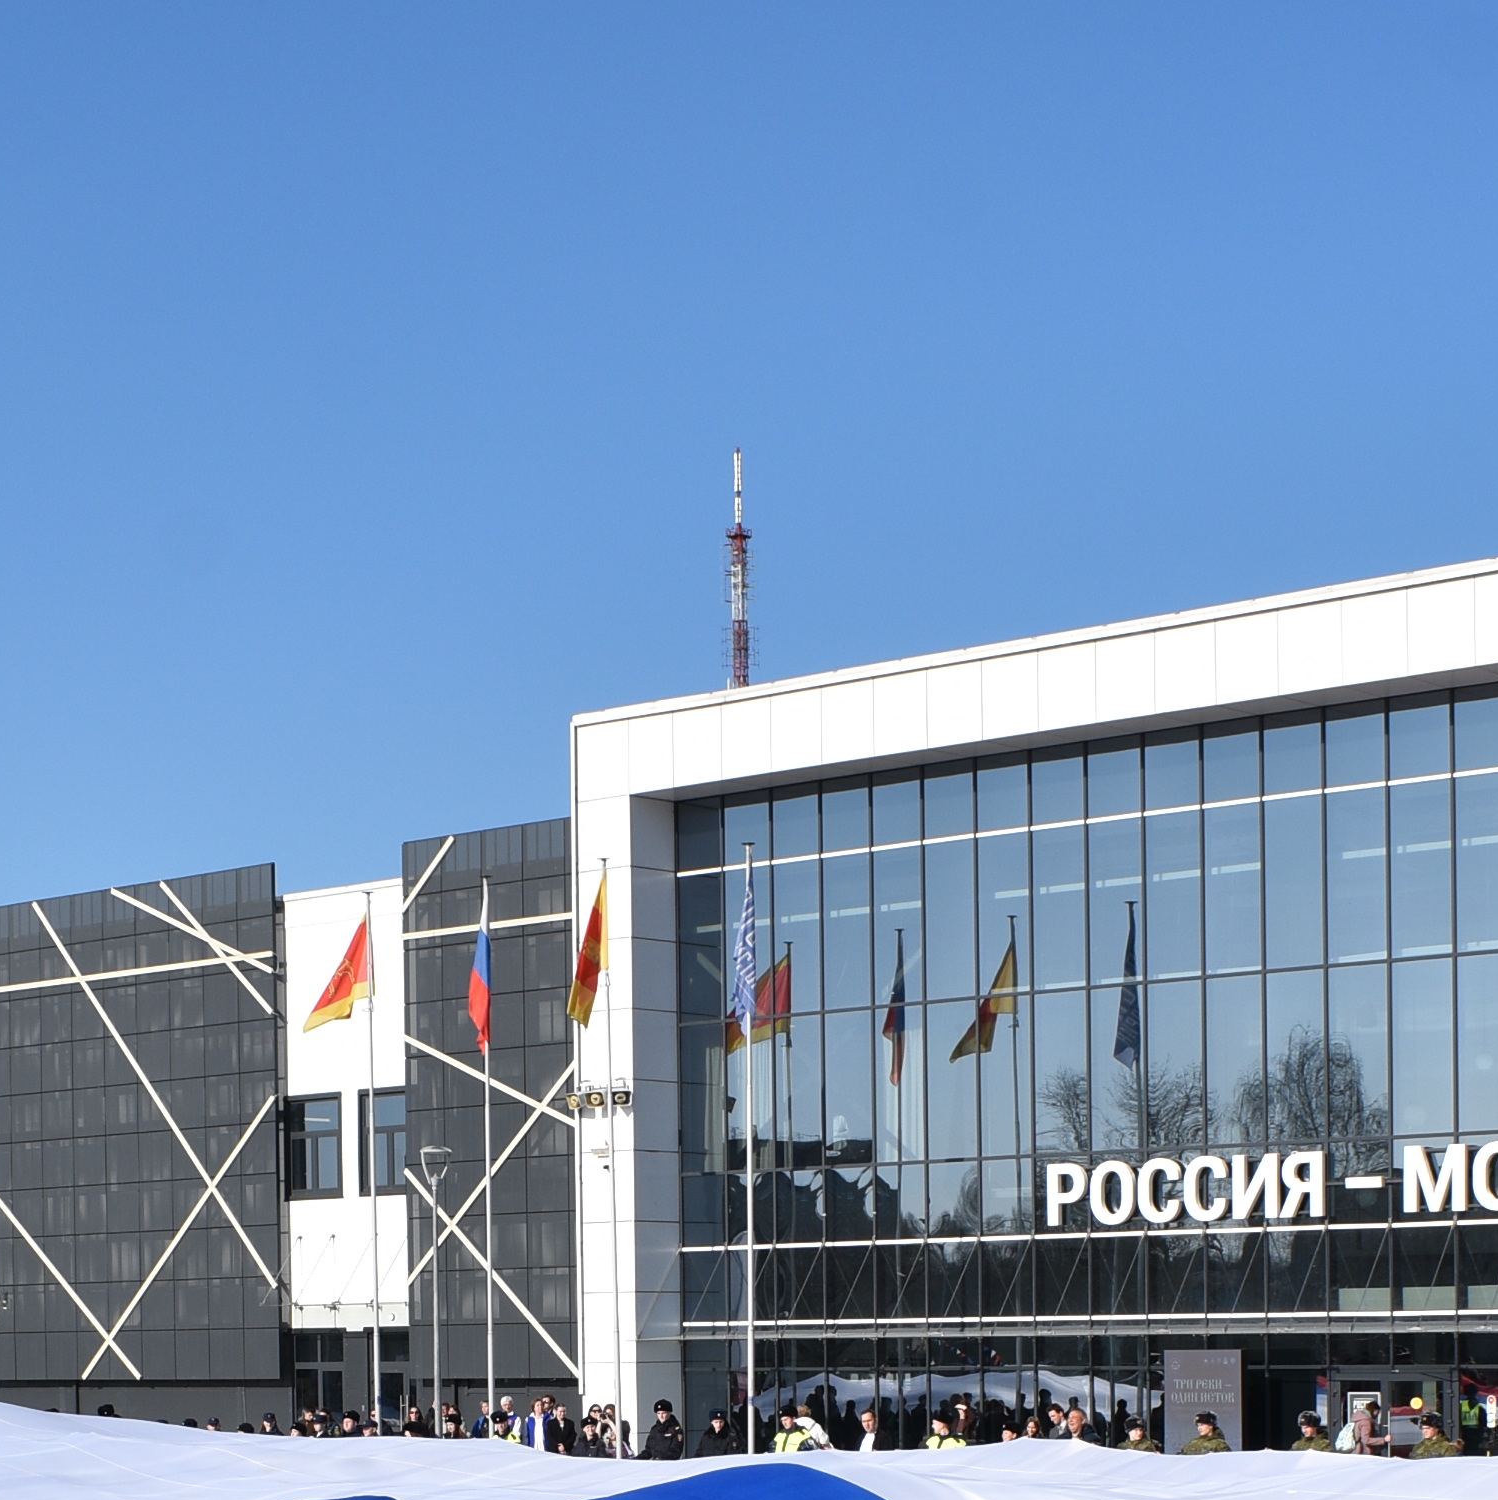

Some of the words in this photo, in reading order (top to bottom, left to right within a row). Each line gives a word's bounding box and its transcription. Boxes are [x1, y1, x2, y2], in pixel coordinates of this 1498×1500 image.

[1046, 1150, 1325, 1227] РОССИЯ
[1173, 1378, 1193, 1390] ТРИ
[1196, 1378, 1222, 1390] РЕКИ
[1171, 1391, 1198, 1404] ОДИН
[1200, 1391, 1235, 1403] ИСТОК
